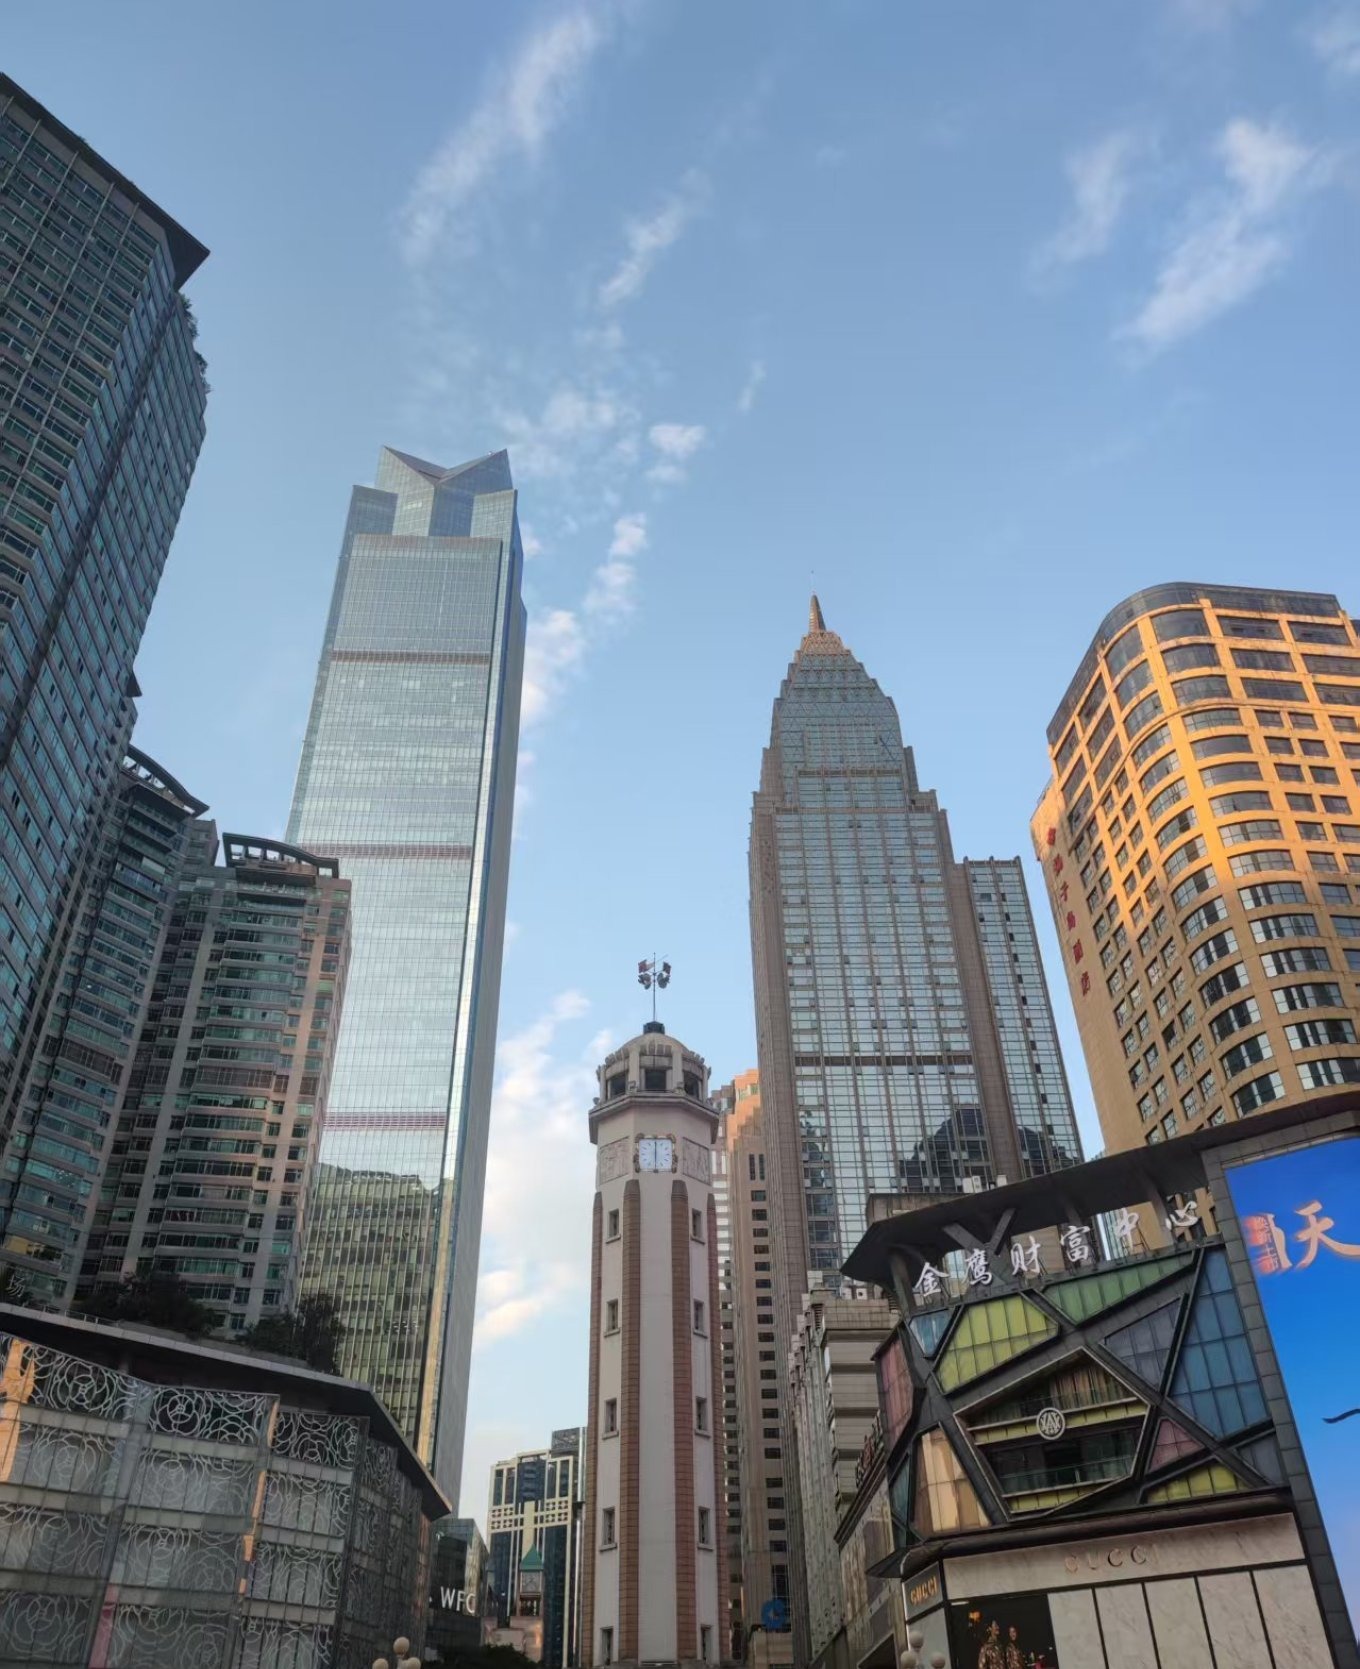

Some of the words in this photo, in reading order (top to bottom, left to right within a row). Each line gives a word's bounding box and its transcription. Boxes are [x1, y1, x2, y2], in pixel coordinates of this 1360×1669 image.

[913, 1197, 1200, 1297] 金鹰财富中心
[1065, 1543, 1159, 1574] GUCCI
[910, 1575, 938, 1606] GUCCI
